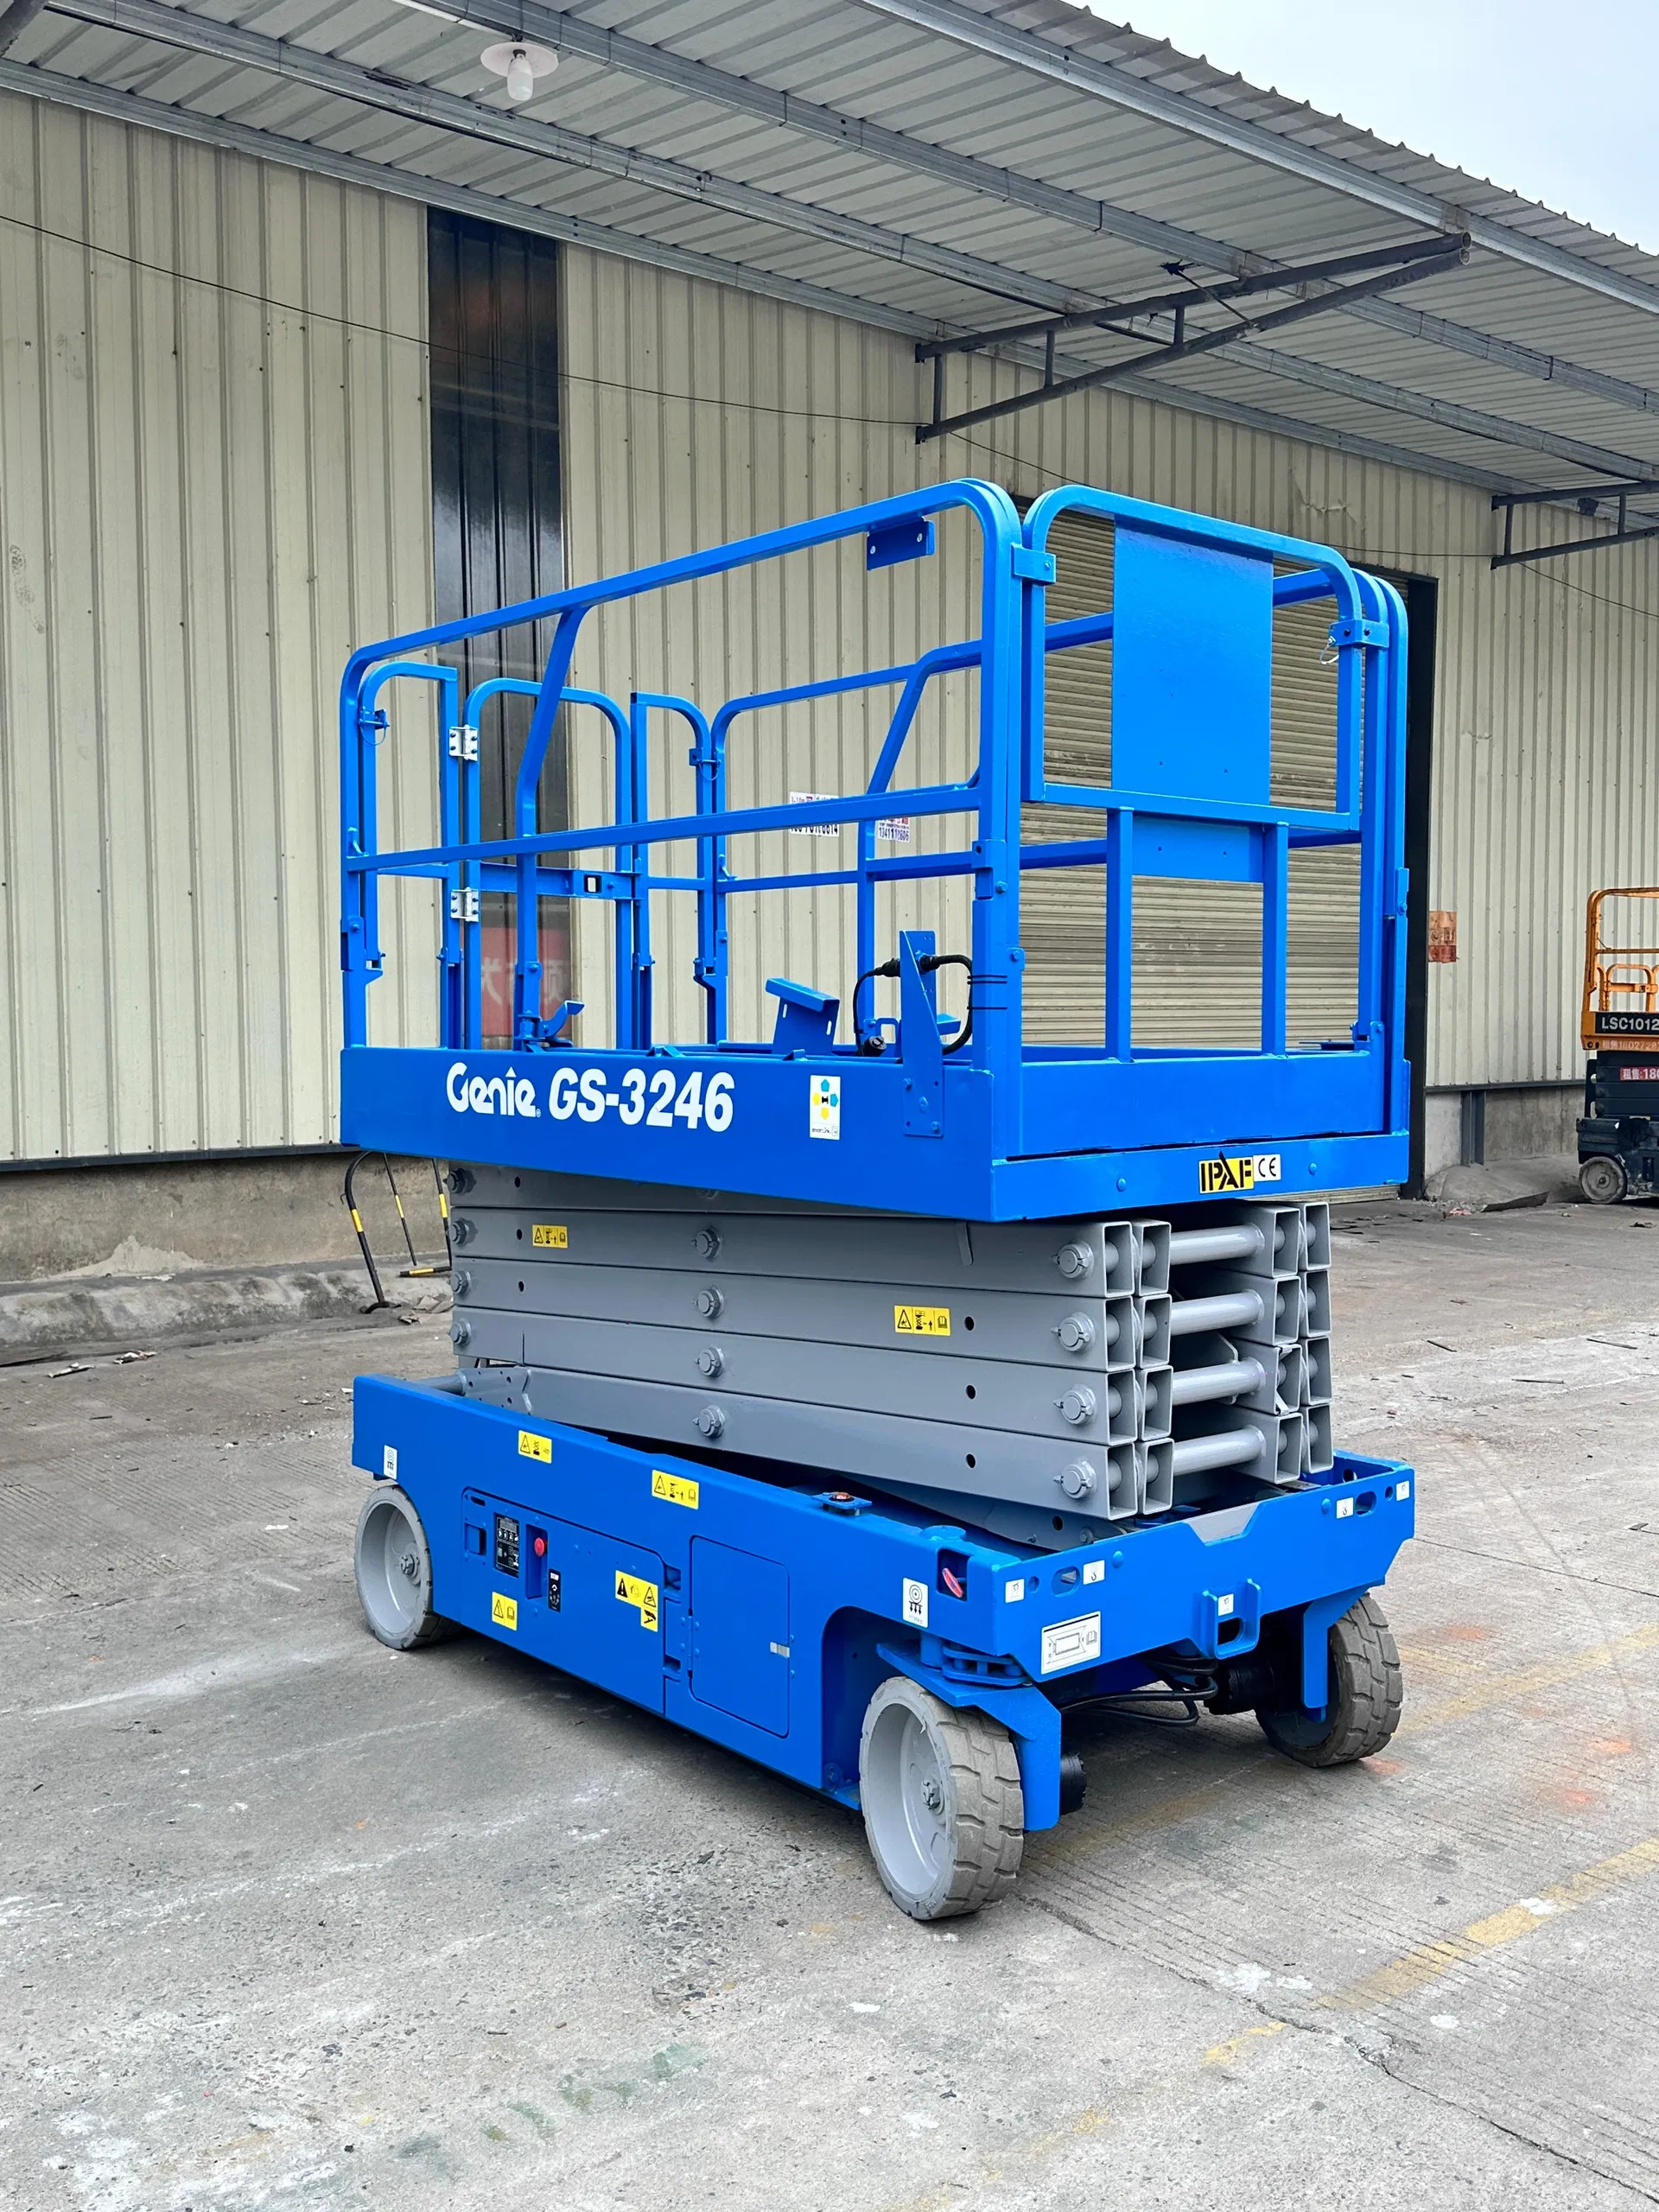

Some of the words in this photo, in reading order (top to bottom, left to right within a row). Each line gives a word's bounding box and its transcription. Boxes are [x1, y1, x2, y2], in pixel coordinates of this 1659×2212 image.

[549, 1067, 734, 1132] GS-3246
[1200, 1150, 1252, 1192] IPAF
[1258, 1157, 1277, 1178] CE
